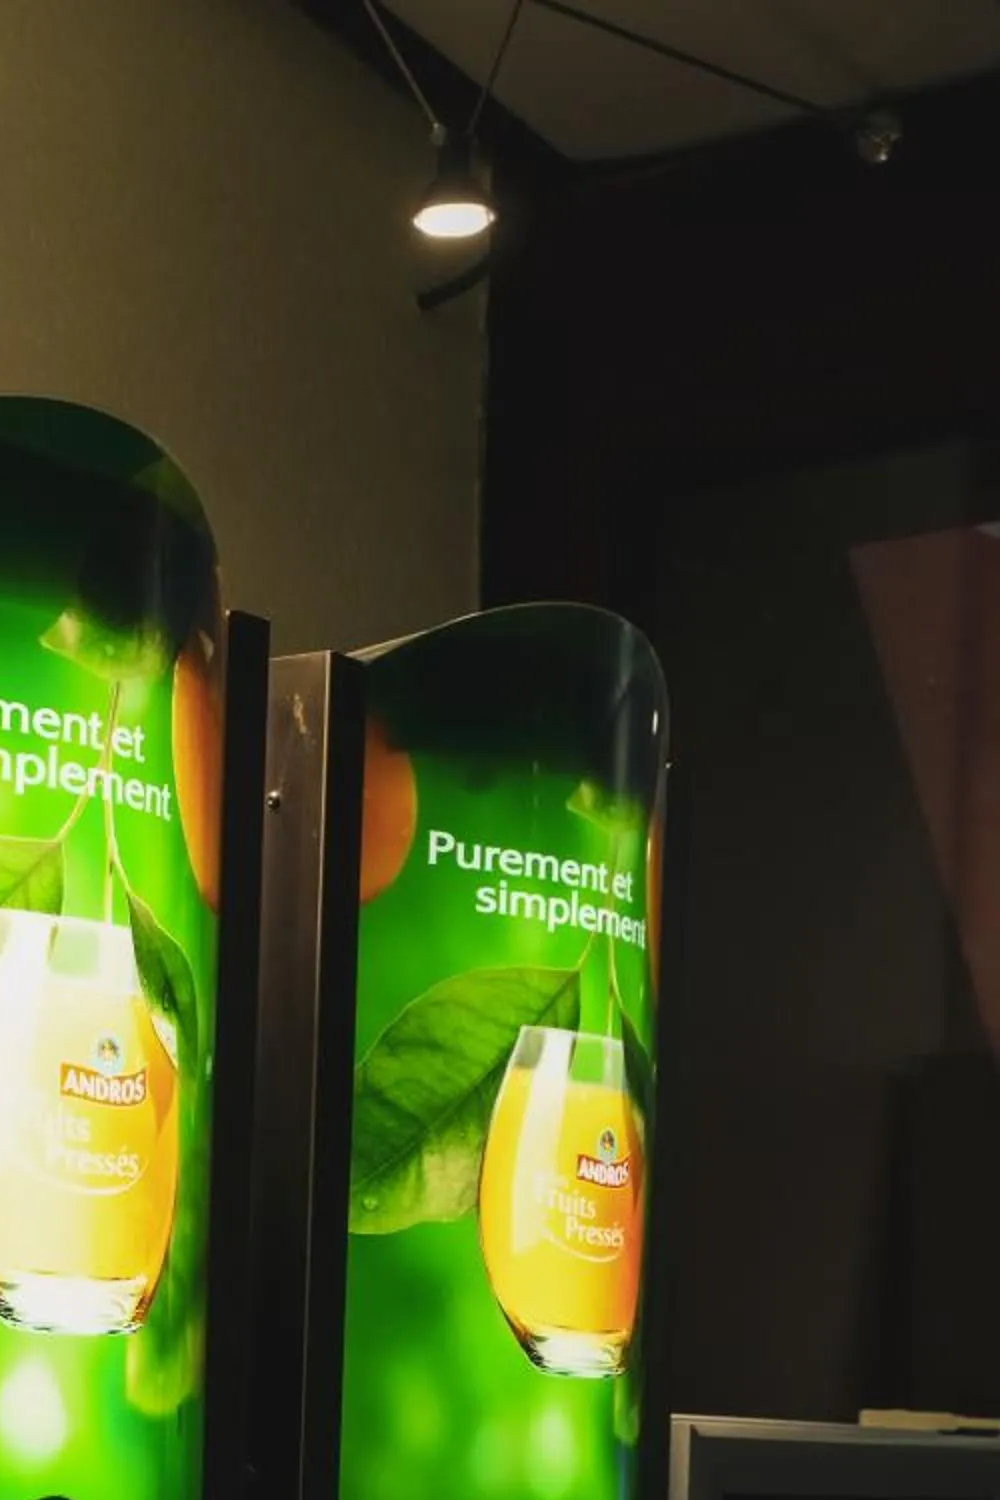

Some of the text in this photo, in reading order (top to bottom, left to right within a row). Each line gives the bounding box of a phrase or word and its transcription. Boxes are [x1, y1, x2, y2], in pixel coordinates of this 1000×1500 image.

[111, 725, 146, 764] et
[427, 829, 634, 904] Purement et
[474, 880, 647, 951] simplement
[62, 1068, 145, 1105] ANDROS
[577, 1157, 629, 1187] ANDROS
